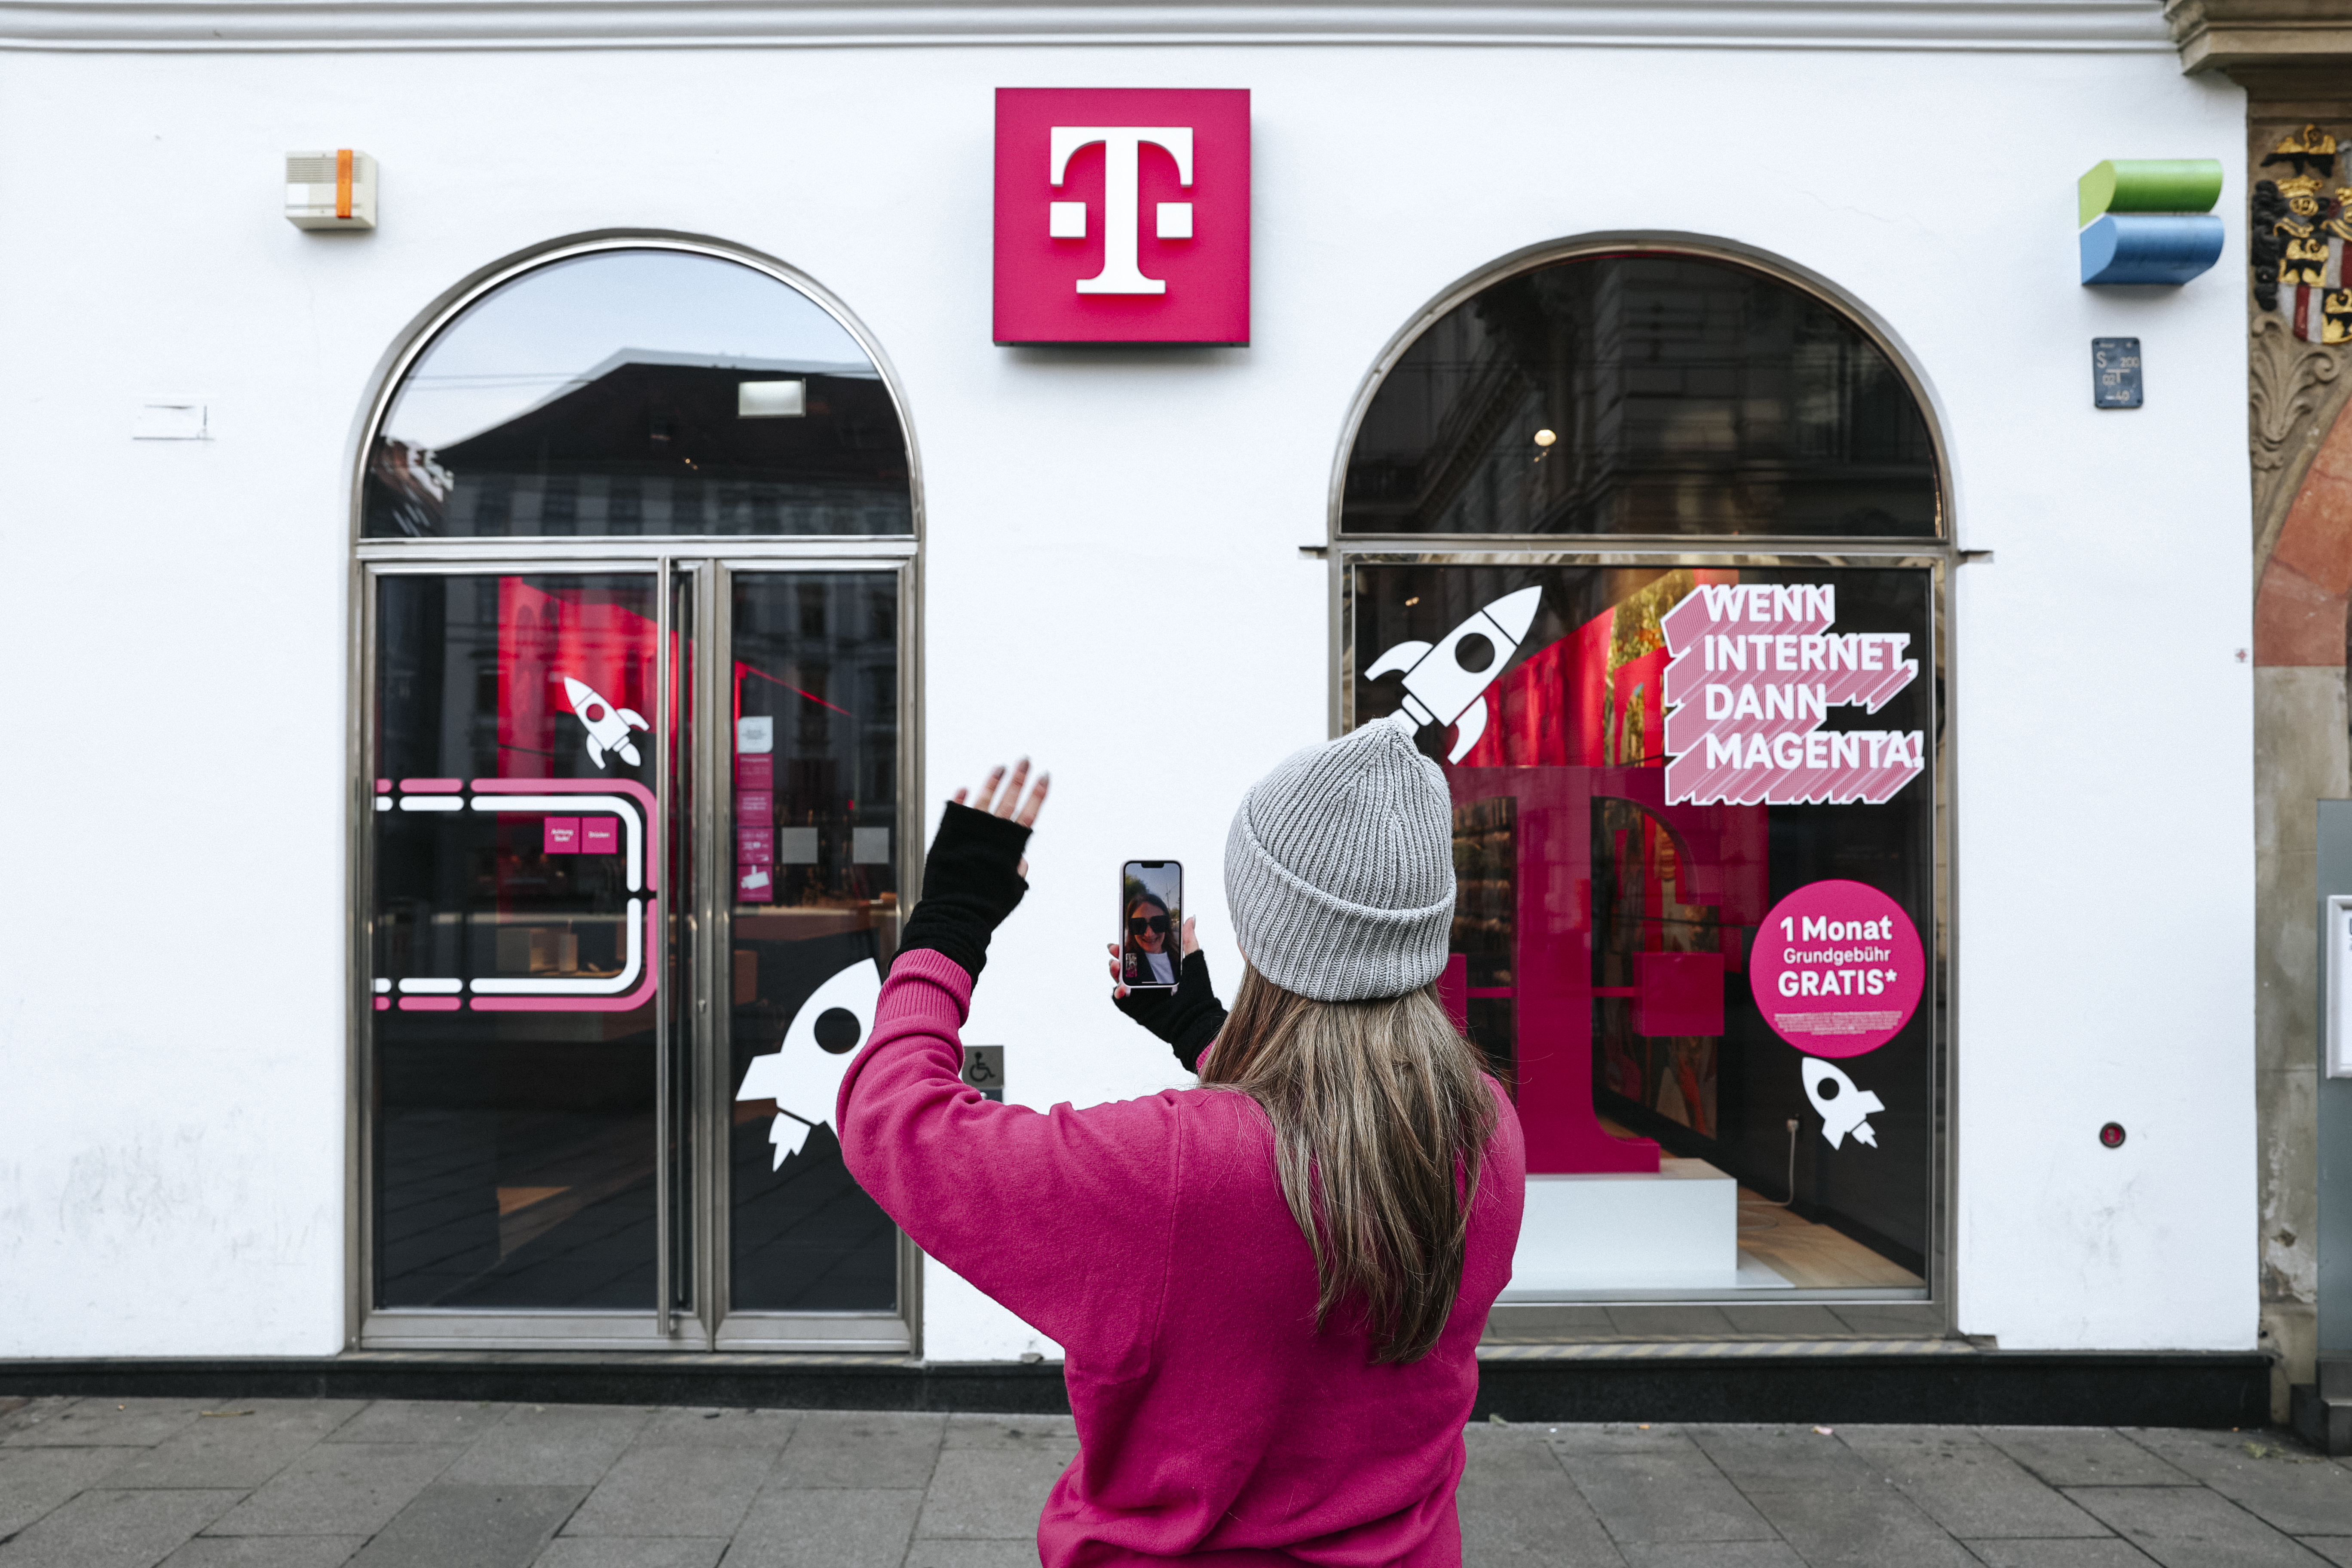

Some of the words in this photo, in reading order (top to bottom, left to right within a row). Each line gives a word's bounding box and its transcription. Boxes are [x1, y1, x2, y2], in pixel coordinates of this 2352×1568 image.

[1050, 126, 1193, 294] T
[1700, 584, 1835, 622] WENN
[1705, 683, 1826, 720] DANN
[1706, 730, 1925, 770] MAGENTA!
[1780, 916, 1794, 942] 1
[1802, 915, 1893, 942] Monat
[1783, 946, 1891, 966] Grundgebühr
